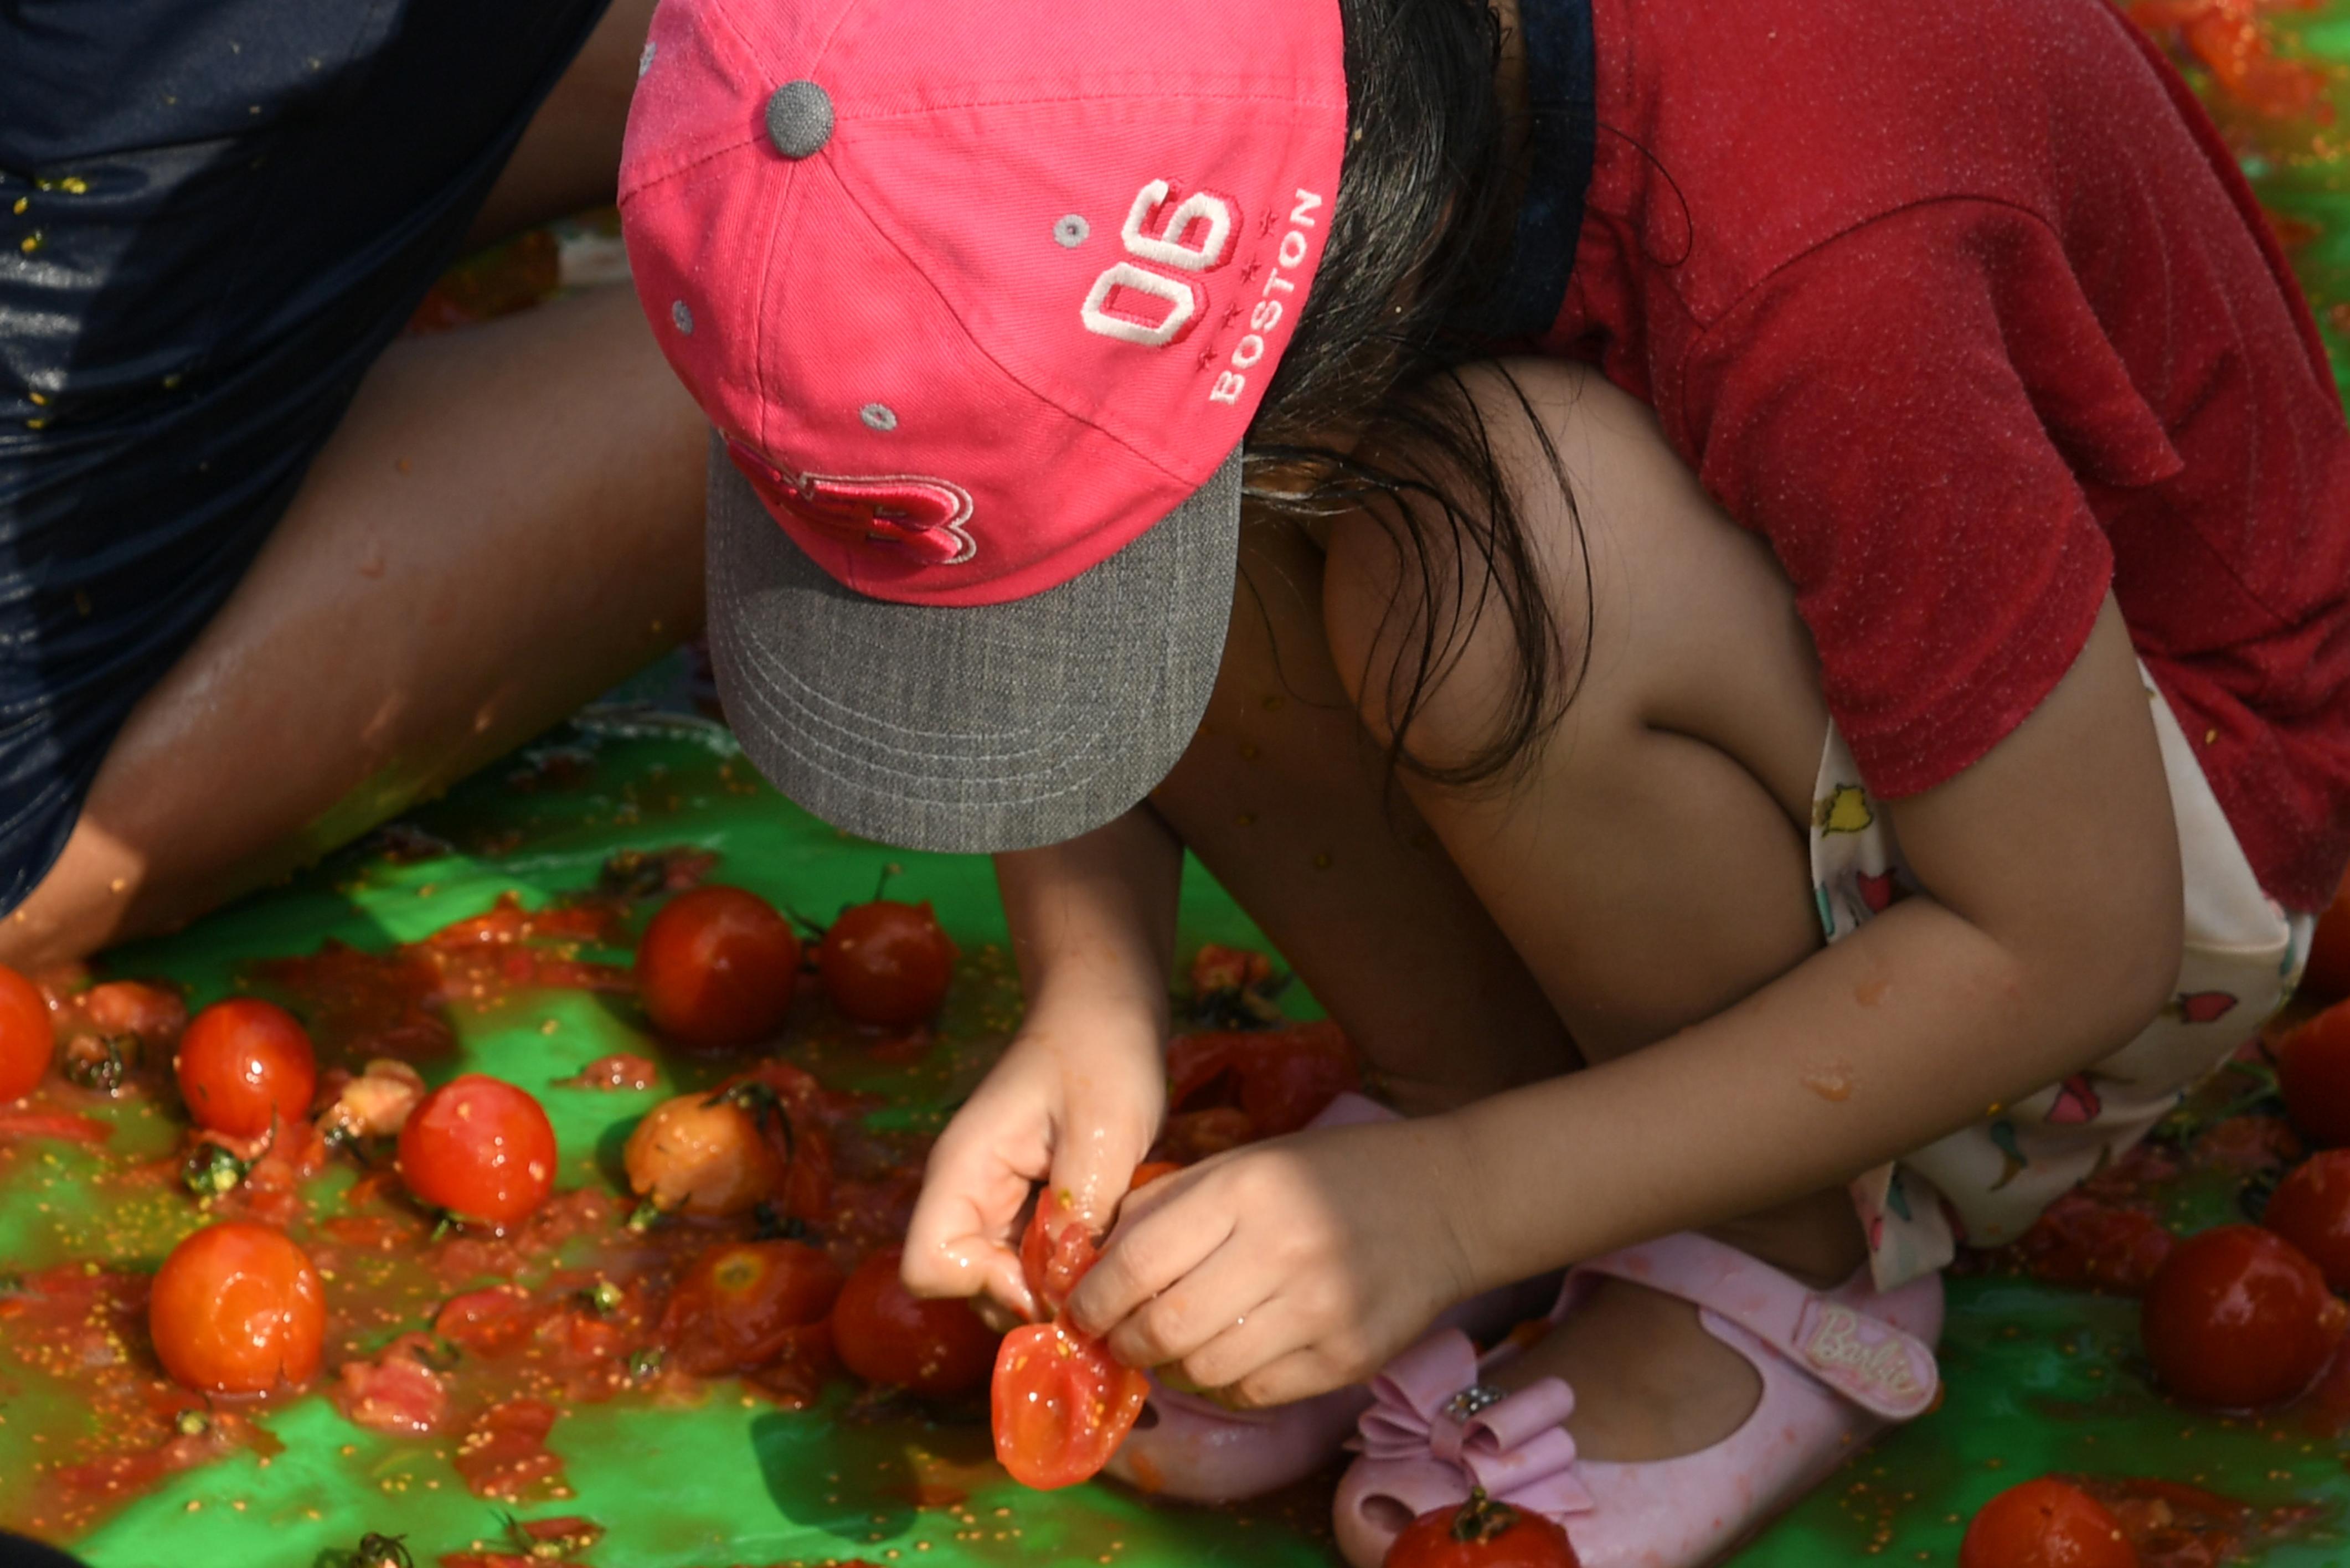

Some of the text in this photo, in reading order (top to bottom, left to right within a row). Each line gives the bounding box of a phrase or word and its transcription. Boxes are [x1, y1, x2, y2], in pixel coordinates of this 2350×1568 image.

[1081, 178, 1238, 348] 06
[1209, 188, 1322, 405] BOSTON
[1810, 1304, 1920, 1395] Barbie
